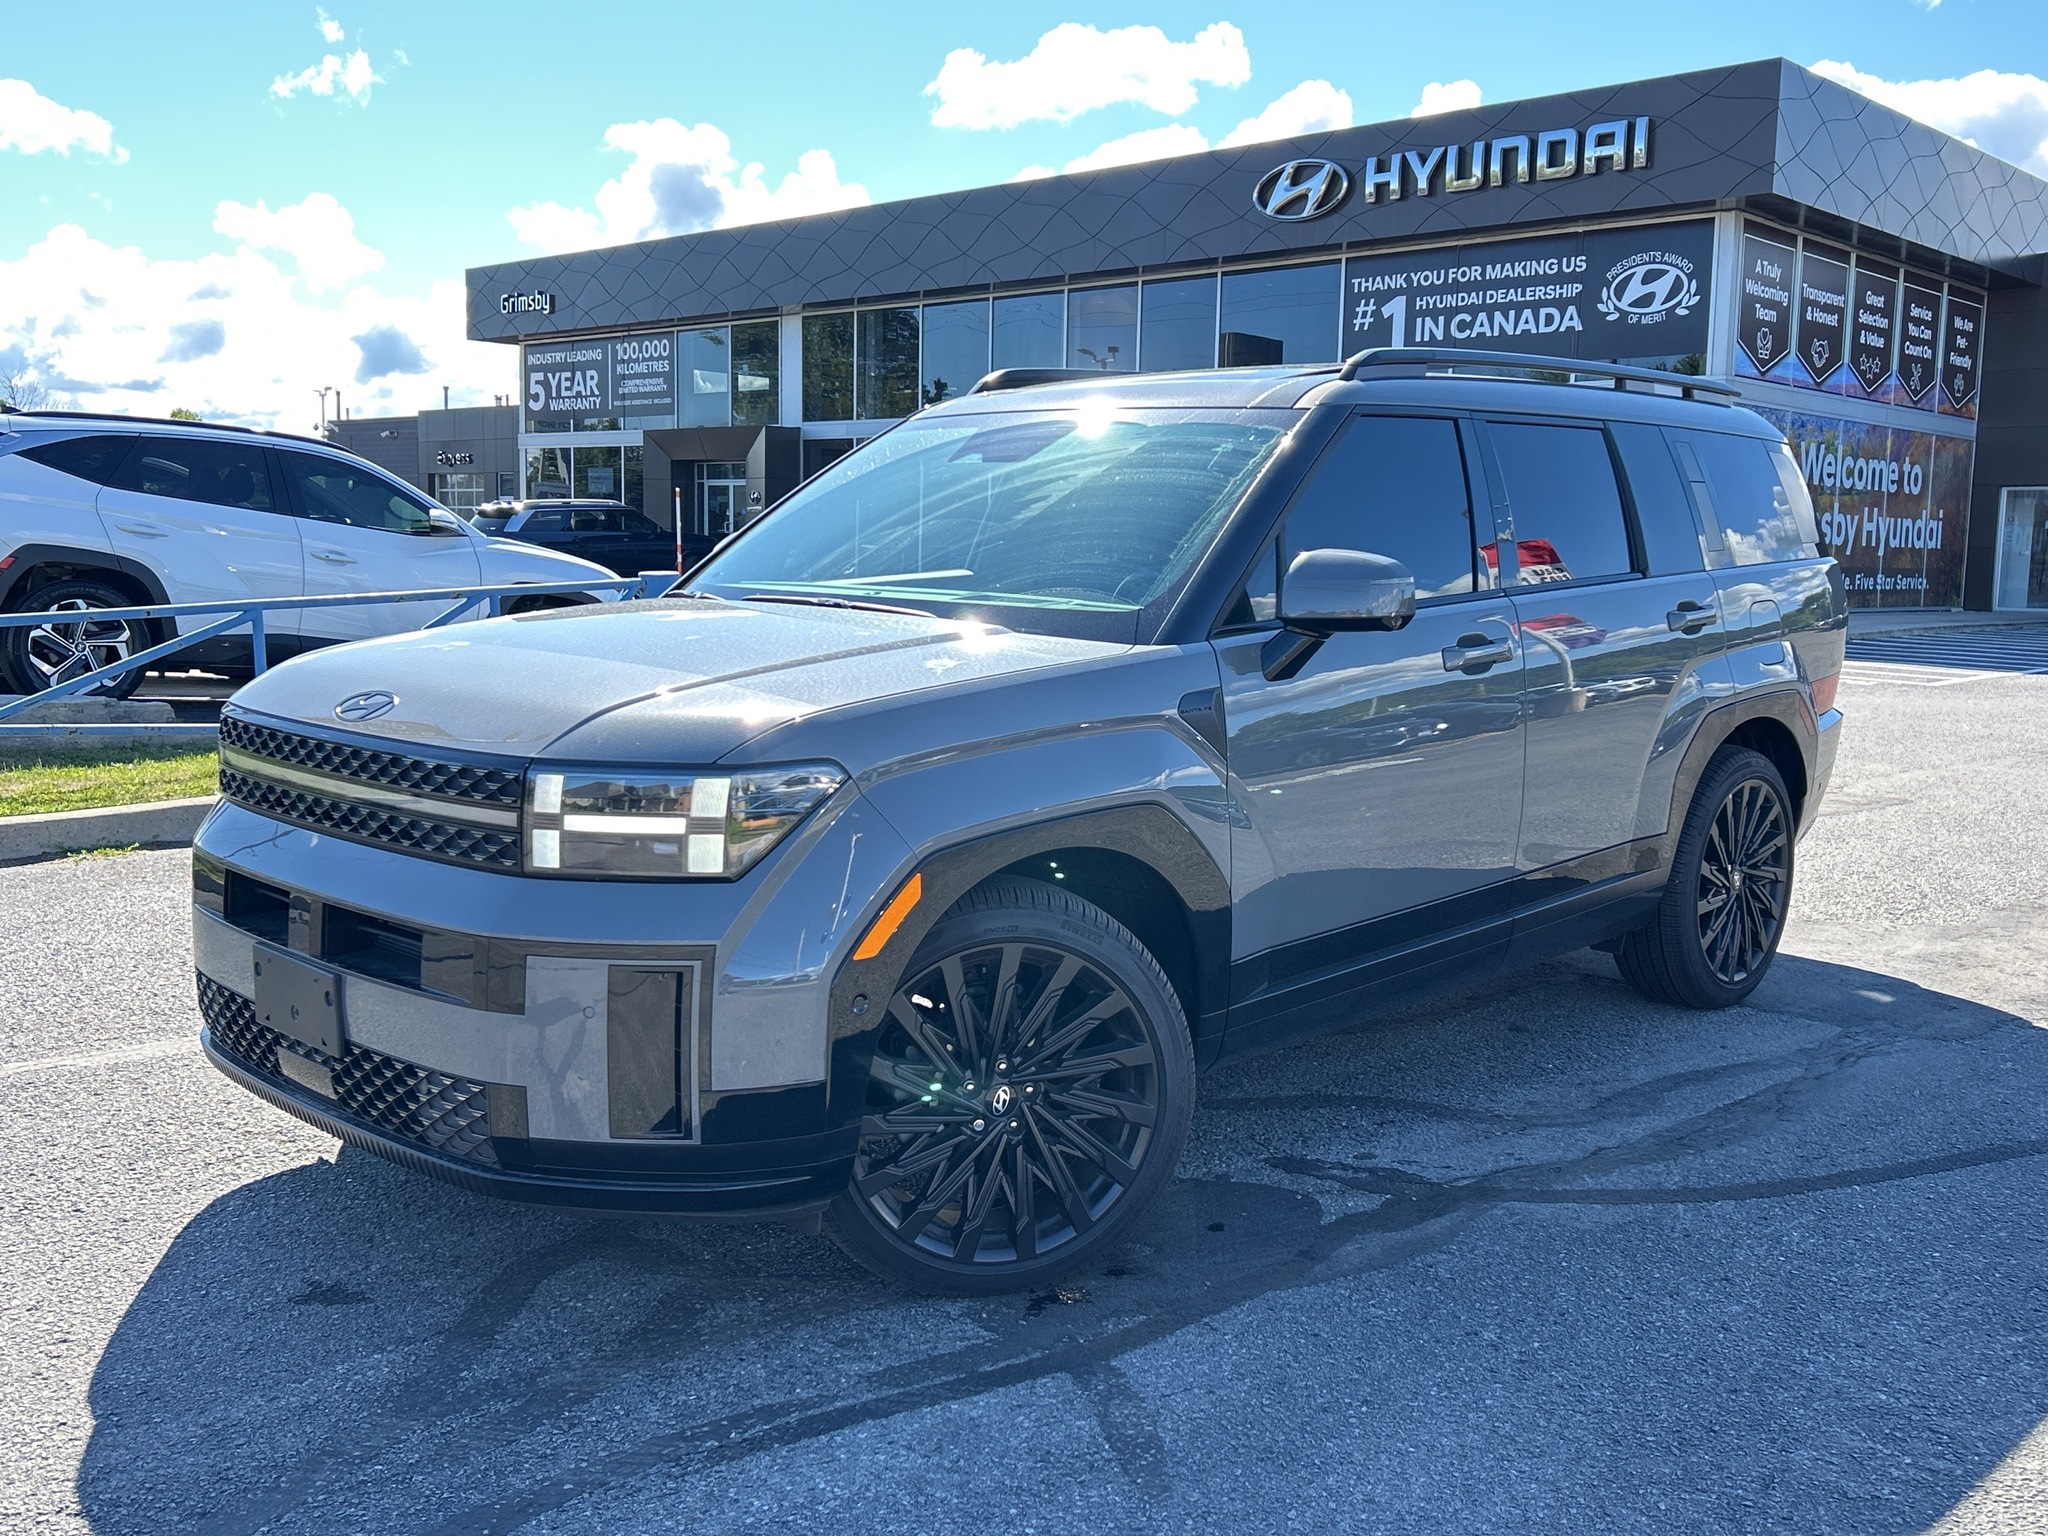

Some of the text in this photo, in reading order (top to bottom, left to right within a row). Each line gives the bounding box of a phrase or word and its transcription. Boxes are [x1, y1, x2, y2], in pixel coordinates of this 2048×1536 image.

[1365, 116, 1650, 204] HYUNDAI
[1351, 255, 1587, 293] THANK YOU FOR MAKING US
[1606, 251, 1694, 281] PRESIDENT'S AWARD
[1755, 258, 1782, 282] A Truly
[500, 289, 550, 315] Grimsby
[1415, 283, 1583, 310] HYUNDAI DEALERSHIP
[1745, 278, 1789, 307] Welcoming
[1802, 283, 1845, 308] Transparent
[1865, 290, 1885, 308] Great
[1627, 310, 1667, 325] OF MERIT
[1755, 303, 1777, 323] Team
[1806, 305, 1838, 327] & Honest
[1858, 308, 1889, 329] Selection
[1910, 303, 1932, 321] Service
[1415, 305, 1584, 342] IN CANADA
[1907, 322, 1932, 340] You Can
[1954, 315, 1974, 332] We Are
[1859, 329, 1885, 348] & Value
[1956, 335, 1969, 349] Pet-
[528, 349, 603, 366] INDUSTRY LEADING
[615, 339, 670, 362] 100,000
[1904, 341, 1932, 360] Count On
[1949, 351, 1972, 371] Friendly
[616, 360, 670, 375] KILOMETRES
[528, 369, 600, 412] 5 YEAR
[549, 396, 602, 412] WARRANTY
[1800, 441, 1923, 496] Welcome to
[1861, 507, 1944, 556] Hyundai
[1855, 572, 1878, 590] Five
[1876, 572, 1895, 590] Star
